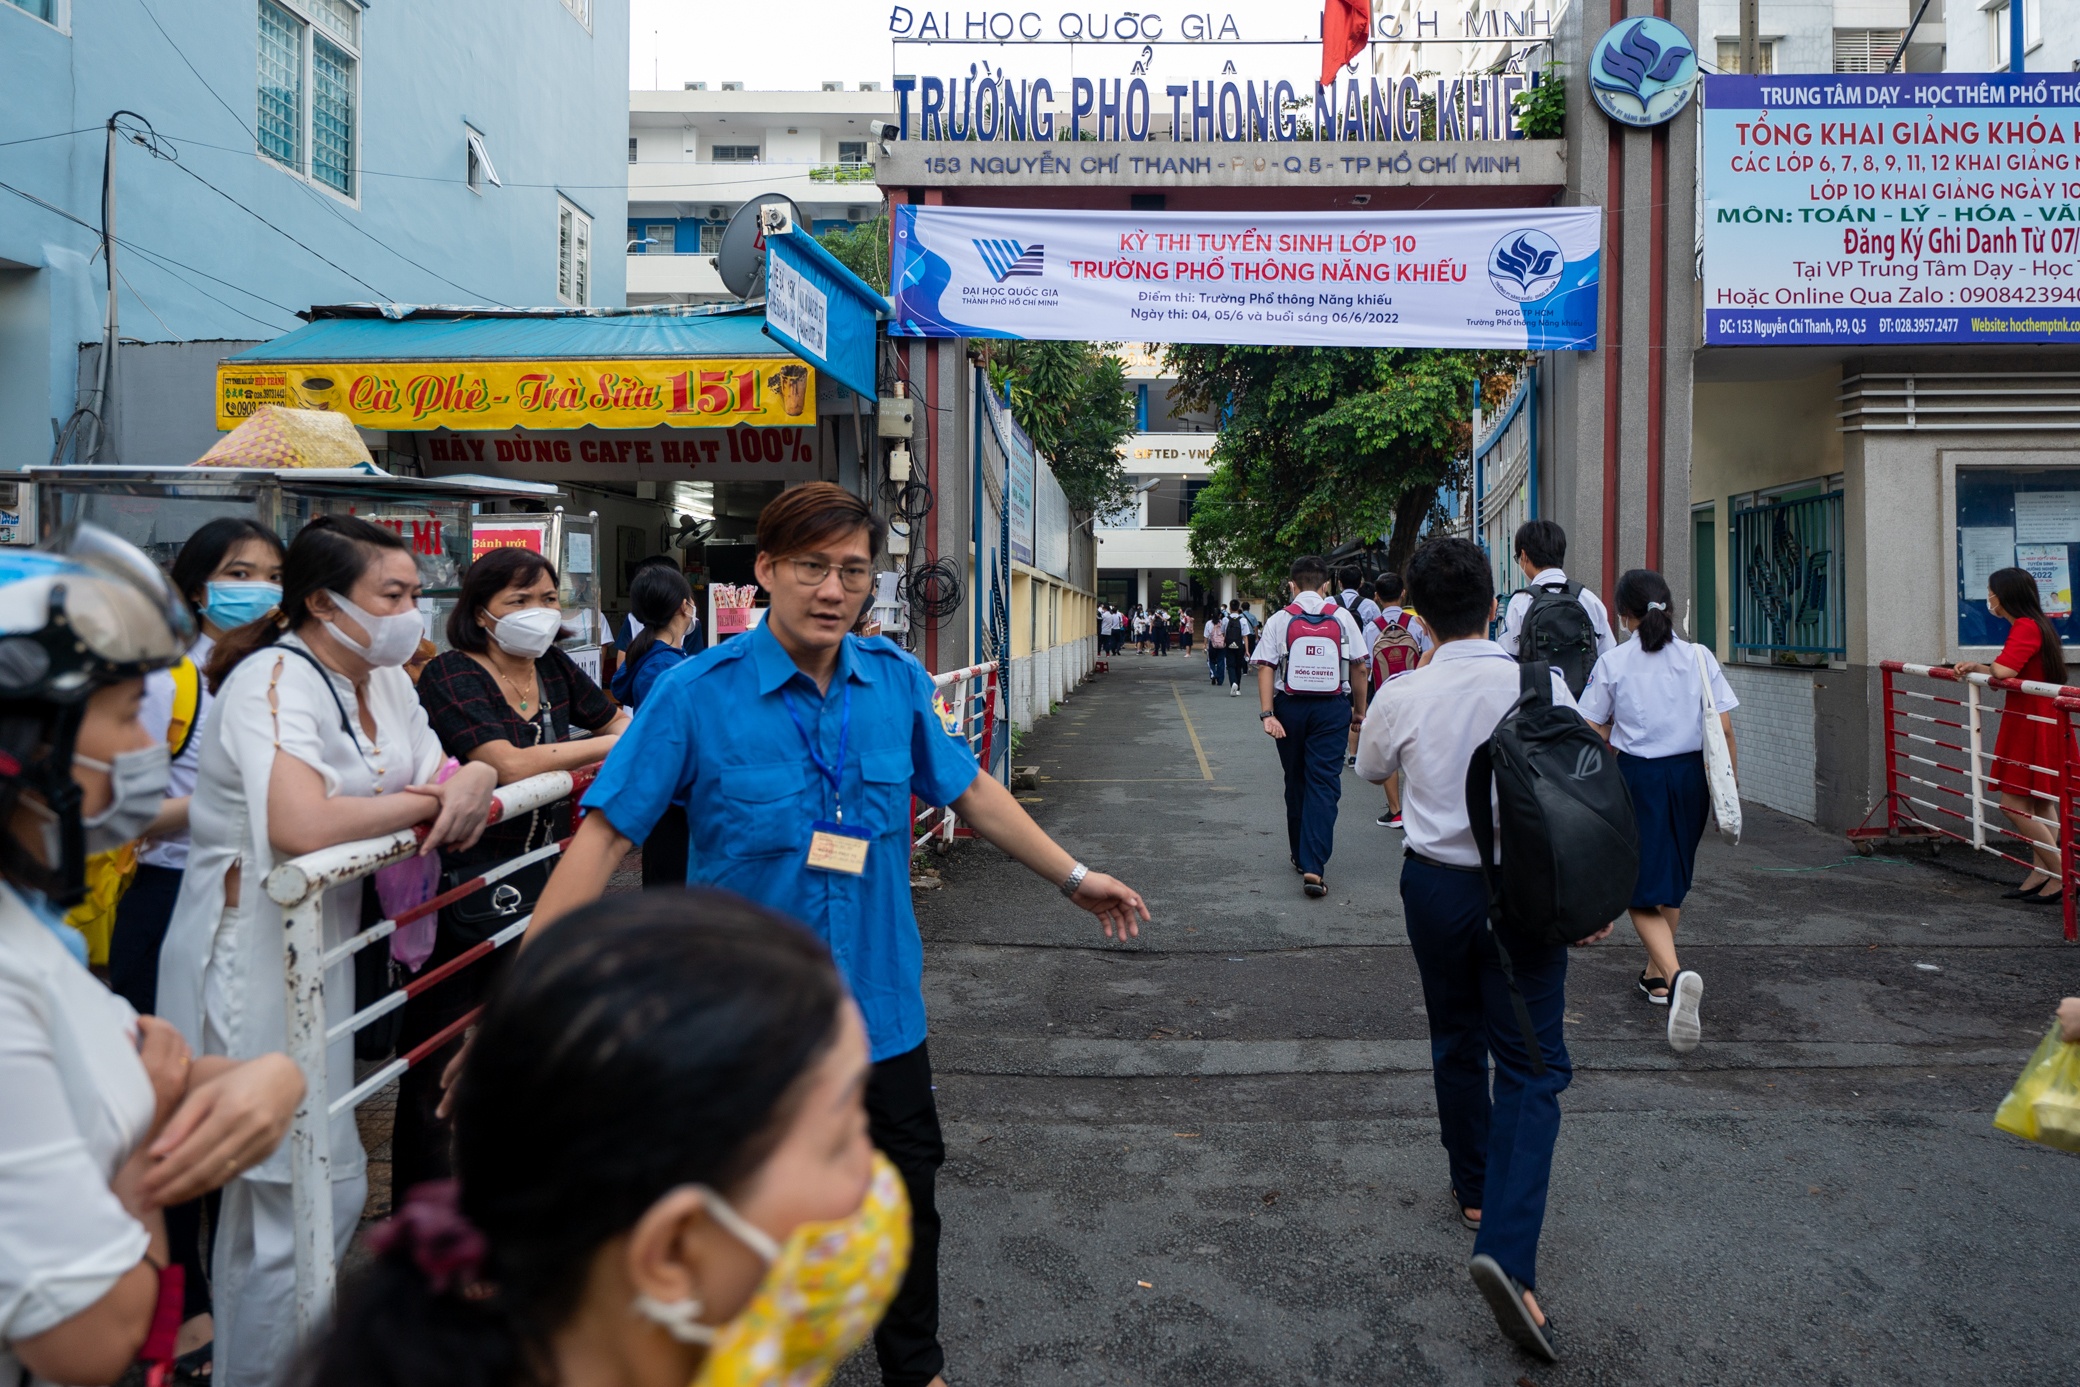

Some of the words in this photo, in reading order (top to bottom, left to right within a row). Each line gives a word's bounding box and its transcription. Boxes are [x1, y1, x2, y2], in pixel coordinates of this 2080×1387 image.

[966, 12, 1042, 46] HỌC
[1181, 13, 1240, 40] GIA
[1465, 10, 1550, 37] MINH
[893, 60, 1055, 142] TRƯỜNG
[1071, 45, 1153, 142] PHỔ
[1166, 60, 1298, 142] THÔNG
[1314, 62, 1420, 142] NĂNG
[1760, 86, 1821, 105] TRUNG
[1823, 82, 1867, 104] TÂM
[1870, 86, 1901, 109] DẠY
[1914, 85, 1952, 109] HỌC
[1954, 82, 2005, 104] THÊM
[2009, 79, 2048, 103] PHỔ
[1735, 110, 1813, 145] TỔNG
[1820, 122, 1884, 145] KHAI
[1892, 113, 1980, 145] GIẢNG
[1988, 114, 2066, 145] KHÓA
[924, 157, 961, 174] 153
[970, 150, 1071, 174] NGUYỄN
[1080, 153, 1121, 174] CHÍ
[1129, 156, 1211, 174] THANH
[1340, 157, 1371, 174] TP
[1377, 150, 1412, 174] HỒ
[1418, 153, 1459, 174] CHÍ
[1465, 156, 1521, 173] MINH
[1730, 151, 1771, 172] CÁC
[1776, 152, 1814, 172] LỚP
[1819, 155, 1836, 175] 6,
[1841, 155, 1857, 174] 7,
[1863, 155, 1879, 174] 8,
[1885, 155, 1901, 173] 9,
[1907, 155, 1926, 173] 11,
[1931, 154, 1950, 171] 12
[1955, 153, 2001, 171] KHAI
[2006, 147, 2070, 171] GIẢNG
[1810, 179, 1848, 201] LỚP
[1853, 184, 1876, 200] 10
[1881, 183, 1927, 200] KHAI
[1932, 177, 1995, 200] GIẢNG
[2000, 177, 2056, 199] NGÀY
[1716, 205, 1793, 224] MÔN:
[1799, 206, 1876, 223] TOÁN
[1900, 206, 1932, 222] LÝ
[1954, 204, 2016, 222] HÓA
[2038, 203, 2080, 222] VĂ
[1120, 229, 1149, 252] KỲ
[1155, 233, 1191, 252] THI
[1197, 227, 1272, 253] TUYỂN
[1278, 234, 1332, 253] SINH
[1340, 230, 1387, 253] LỚP
[1393, 235, 1417, 253] 10
[1844, 228, 1895, 261] Đăng
[1900, 228, 1924, 260] Ký
[1928, 227, 1961, 254] Ghi
[1967, 226, 2017, 254] Danh
[2021, 226, 2046, 253] Từ
[1070, 256, 1169, 280] TRƯỜNG
[1175, 256, 1224, 281] PHỔ
[1231, 258, 1315, 282] THÔNG
[1321, 258, 1390, 282] NĂNG
[1397, 257, 1467, 283] KHIẾU
[1793, 259, 1821, 279] Tại
[1826, 260, 1853, 277] VP
[1858, 260, 1917, 281] Trung
[1923, 259, 1967, 277] Tâm
[1973, 260, 2014, 281] Dạy
[2033, 260, 2073, 280] Học
[962, 286, 980, 298] ĐẠI
[982, 287, 1005, 298] HỌC
[1007, 286, 1039, 297] QUỐC
[1041, 288, 1059, 297] GIA
[962, 296, 989, 305] THÀNH
[1022, 297, 1036, 306] CHÍ
[1038, 299, 1058, 307] MINH
[1138, 291, 1171, 303] Điểm
[1175, 292, 1196, 304] thi:
[1199, 292, 1246, 307] Trường
[1249, 291, 1275, 305] Phổ
[1277, 293, 1315, 308] thông
[1318, 293, 1353, 307] Năng
[1357, 293, 1392, 306] khiếu
[1717, 288, 1770, 308] Hoặc
[1775, 287, 1844, 305] Online
[1849, 288, 1892, 308] Qua
[1898, 287, 1944, 304] Zalo
[1960, 287, 2080, 304] 090842394
[1131, 307, 1165, 322] Ngày
[1167, 309, 1188, 320] thi:
[1192, 309, 1211, 322] 04,
[1215, 310, 1243, 322] 05/6
[1247, 311, 1262, 321] và
[1266, 310, 1294, 322] buổi
[1297, 312, 1328, 325] sáng
[1332, 312, 1399, 324] 06/6/2022
[1466, 318, 1494, 328] Trường
[1513, 318, 1536, 328] thông
[1495, 309, 1520, 317] ĐHQG
[1523, 309, 1532, 317] TP
[1535, 309, 1554, 317] HCM
[1719, 318, 1736, 334] ĐC:
[1736, 318, 1752, 333] 153
[1754, 316, 1787, 337] Nguyễn
[1788, 318, 1803, 333] Chí
[1804, 318, 1834, 335] Thanh,
[1835, 318, 1850, 335] P.9,
[1851, 318, 1867, 334] Q.5
[1879, 318, 1894, 333] ĐT:
[1894, 317, 1959, 333] 028.3957.2477
[1971, 317, 2008, 333] Website:
[349, 374, 401, 414] Cà
[407, 373, 491, 421] Phê
[517, 373, 587, 412] Trà
[590, 373, 662, 411] Sữa
[666, 369, 767, 416] 151
[428, 432, 485, 462] HÃY
[494, 433, 572, 463] DÙNG
[579, 439, 654, 464] CAFE
[661, 440, 720, 469] HẠT
[726, 428, 813, 463] 100%
[1134, 448, 1179, 460] GIFTED
[411, 510, 442, 555] MÌ
[472, 538, 502, 548] Bánh
[506, 538, 528, 548] ướt
